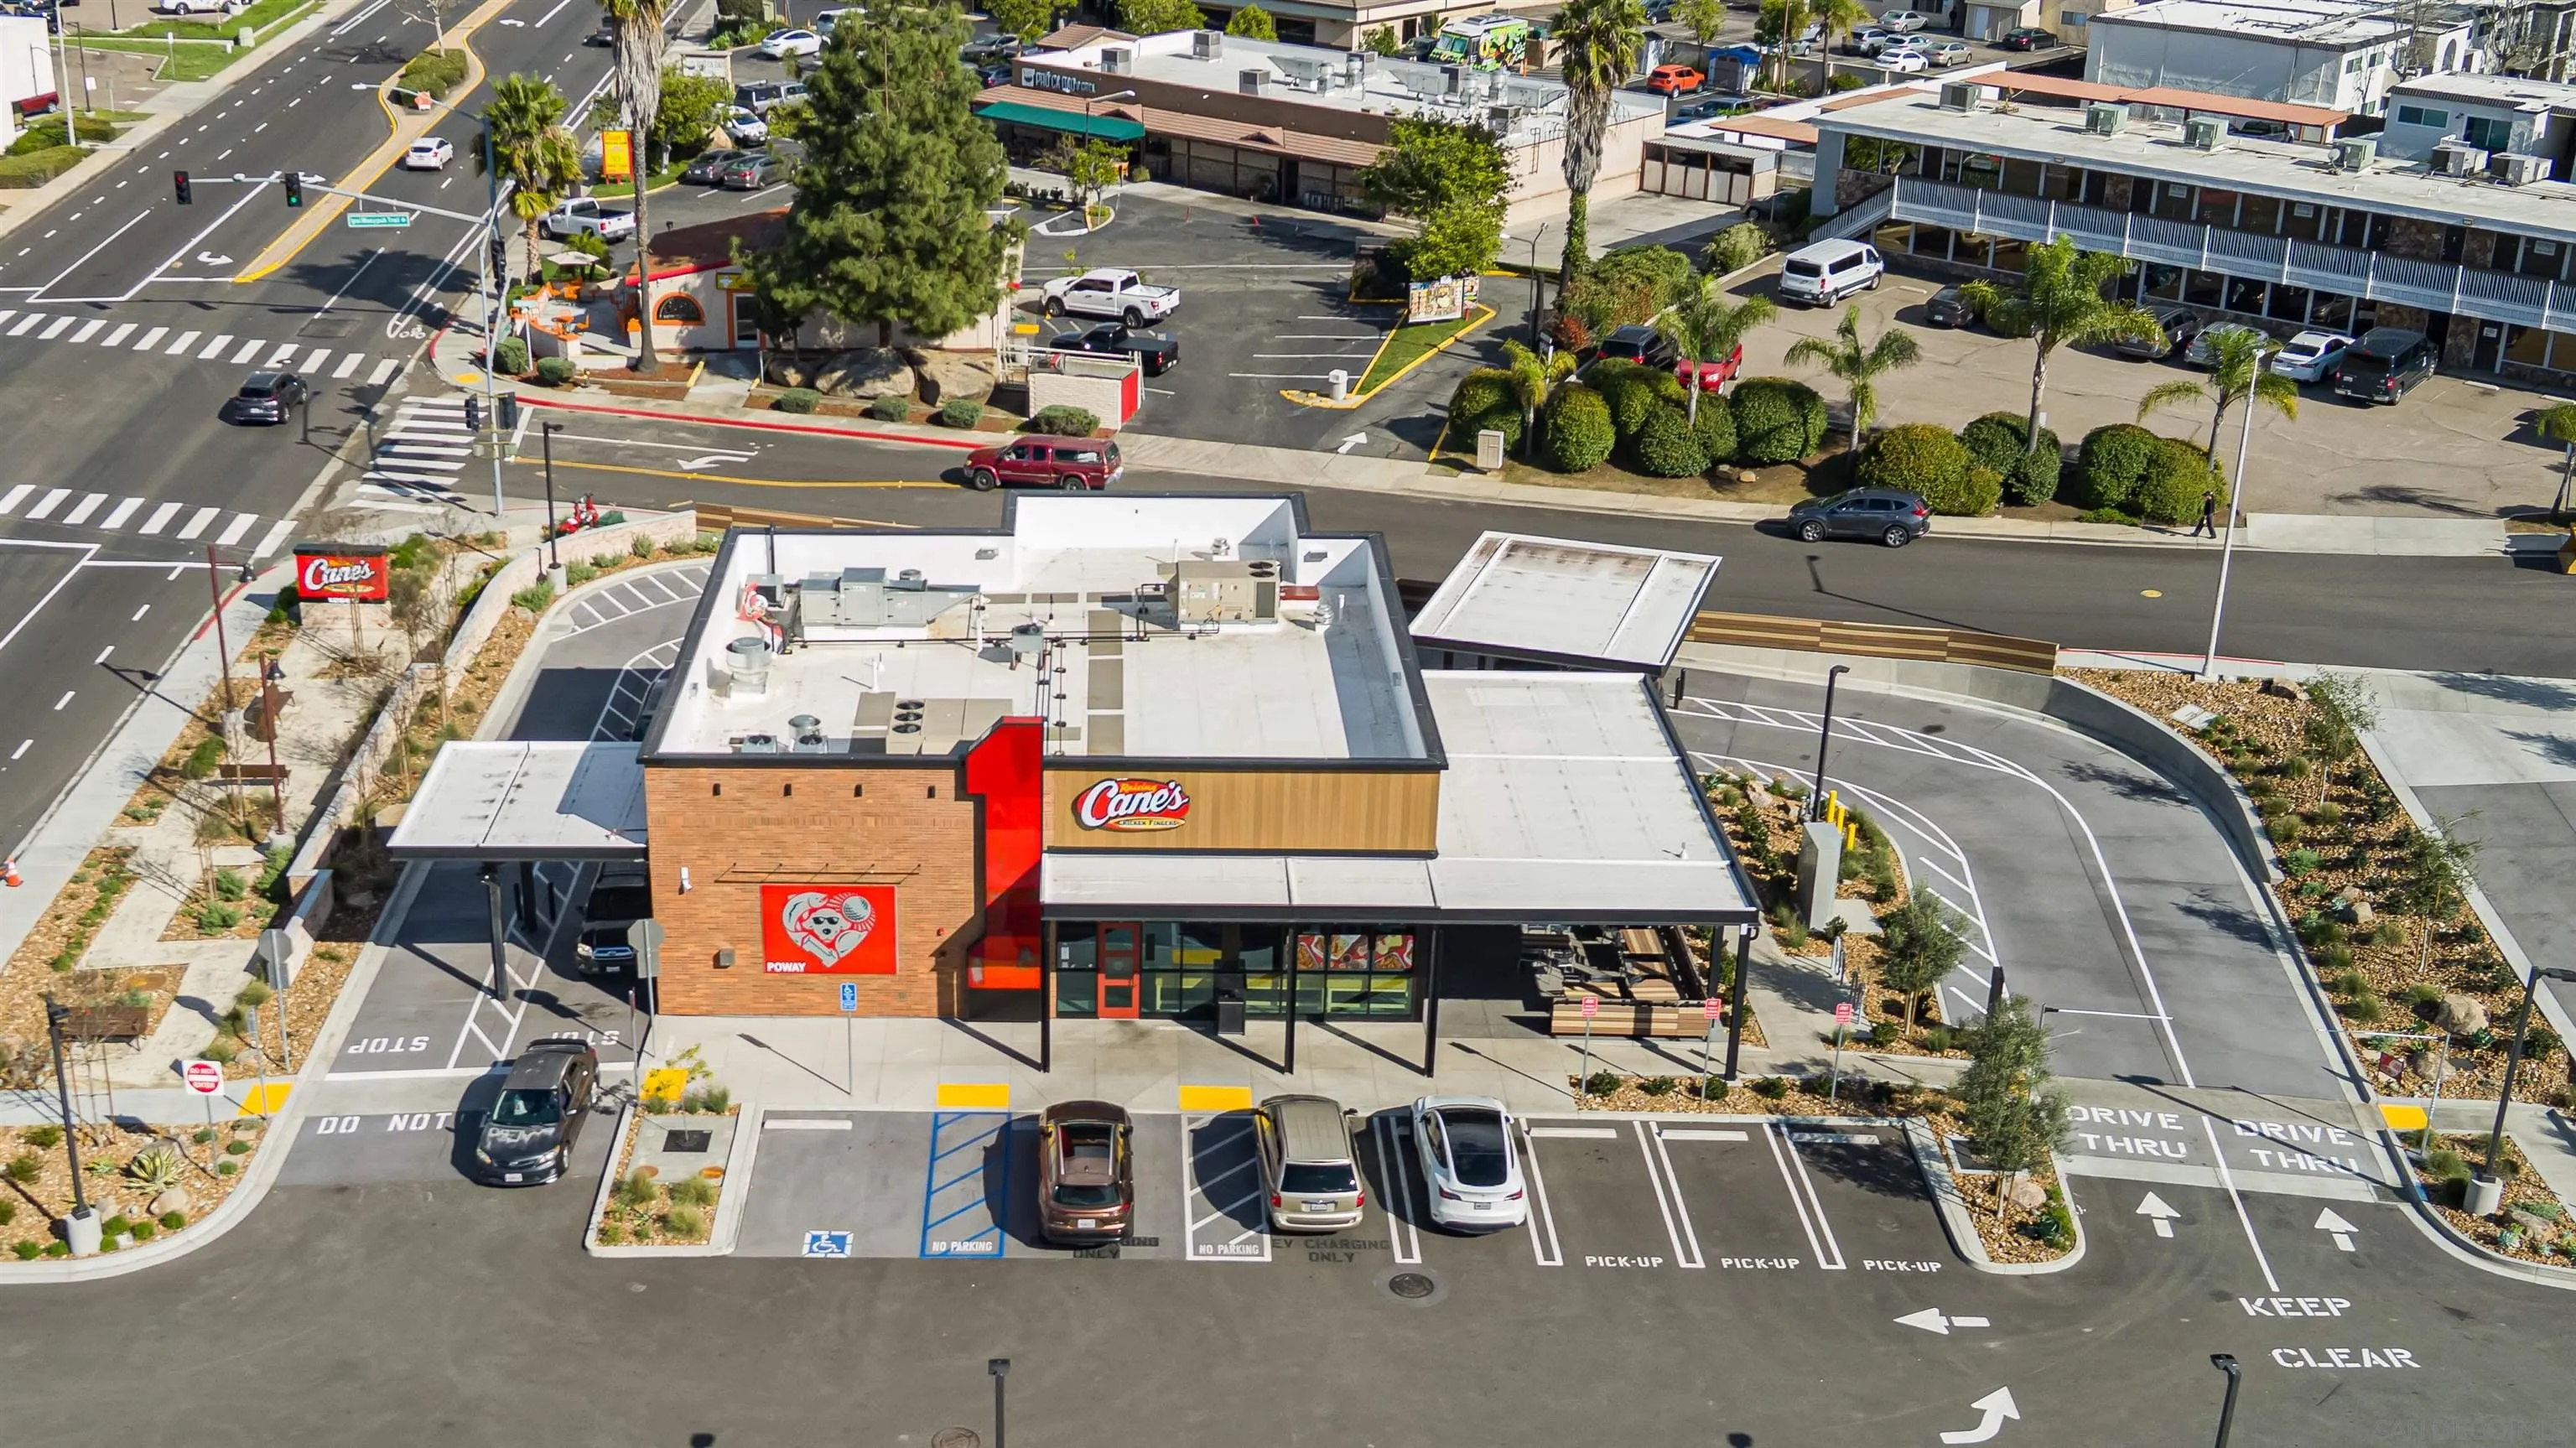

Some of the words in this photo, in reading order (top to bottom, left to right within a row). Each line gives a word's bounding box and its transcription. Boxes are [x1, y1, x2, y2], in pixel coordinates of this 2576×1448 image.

[304, 558, 376, 591] Cane's
[1119, 782, 1158, 793] Raising
[1081, 780, 1189, 828] Cane's
[766, 962, 806, 973] POWAY
[348, 1035, 429, 1055] STOP
[317, 1116, 361, 1134] DO
[387, 1112, 453, 1132] NOT
[2065, 1105, 2184, 1130] DRIVE
[2233, 1119, 2355, 1146] DRIVE
[2079, 1133, 2188, 1158] THRU
[2250, 1149, 2360, 1175] THRU
[932, 1241, 947, 1252] NO
[951, 1241, 993, 1252] PARKING
[1199, 1243, 1213, 1254] NO
[1218, 1243, 1259, 1254] PARKING
[1273, 1238, 1294, 1248] EV
[1304, 1238, 1390, 1250] CHARGING
[1309, 1252, 1355, 1262] ONLY
[1585, 1255, 1664, 1268] PICK-UP
[1721, 1258, 1800, 1269] PICK-UP
[1862, 1259, 1942, 1273] PICK-UP
[2238, 1297, 2351, 1316] KEEP
[2272, 1347, 2423, 1368] CLEAR
